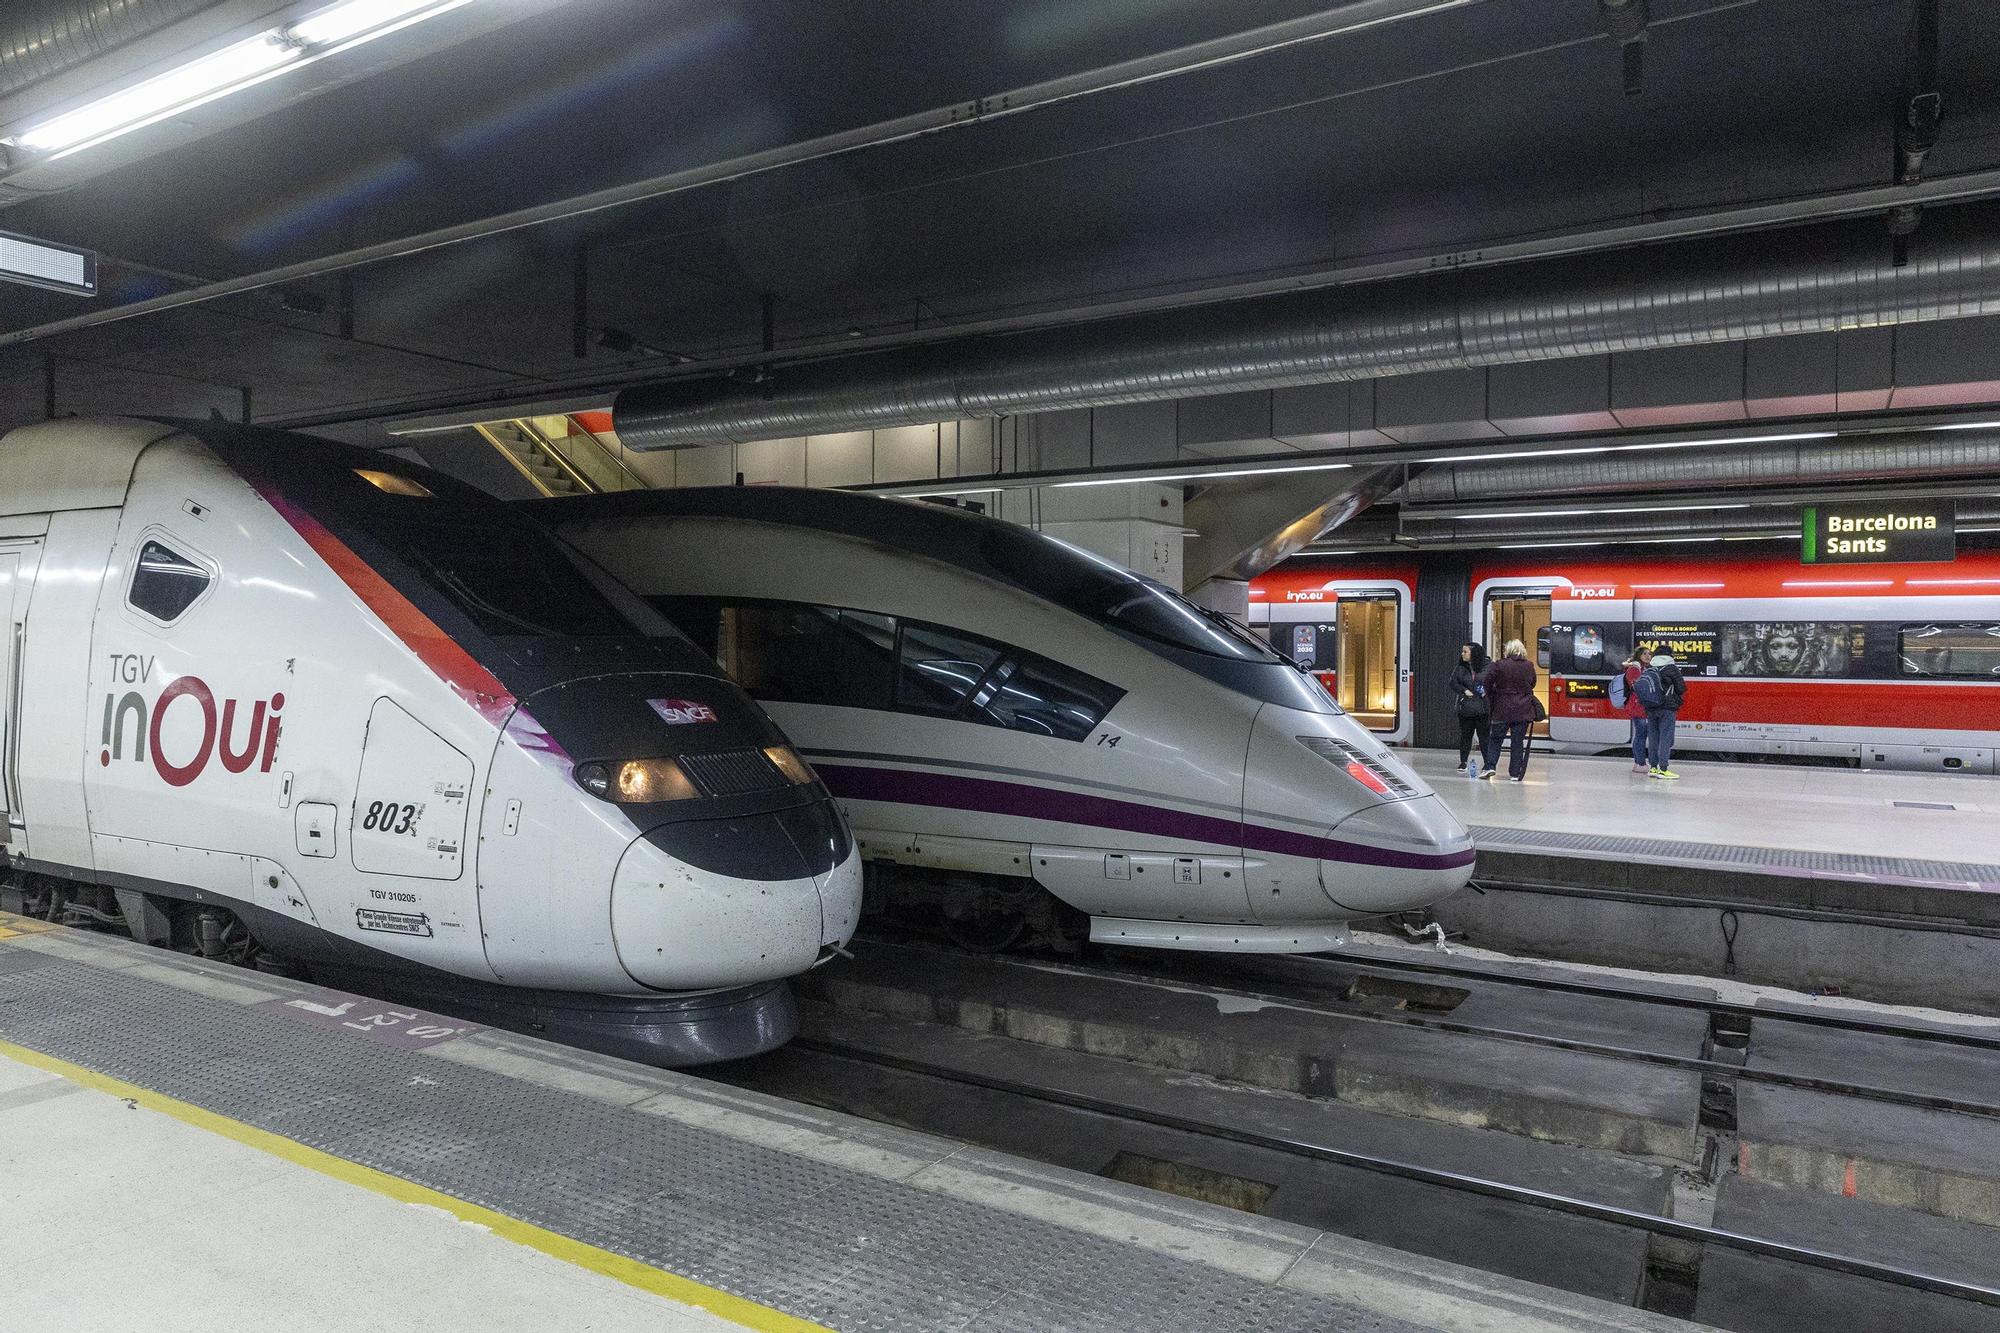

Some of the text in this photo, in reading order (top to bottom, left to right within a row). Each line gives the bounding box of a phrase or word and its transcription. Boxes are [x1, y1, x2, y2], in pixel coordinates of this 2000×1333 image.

[1828, 513, 1937, 532] Barcelona
[1827, 536, 1887, 554] Sants
[1286, 590, 1324, 603] iryo.eu
[1570, 586, 1615, 600] iryo.eu
[1640, 640, 1713, 653] MAINCHE
[110, 654, 155, 684] TGV
[663, 707, 710, 721] SNCF
[1097, 733, 1122, 749] 14
[363, 800, 416, 835] 803
[370, 889, 417, 903] TGV 310205
[409, 924, 420, 933] SNCF
